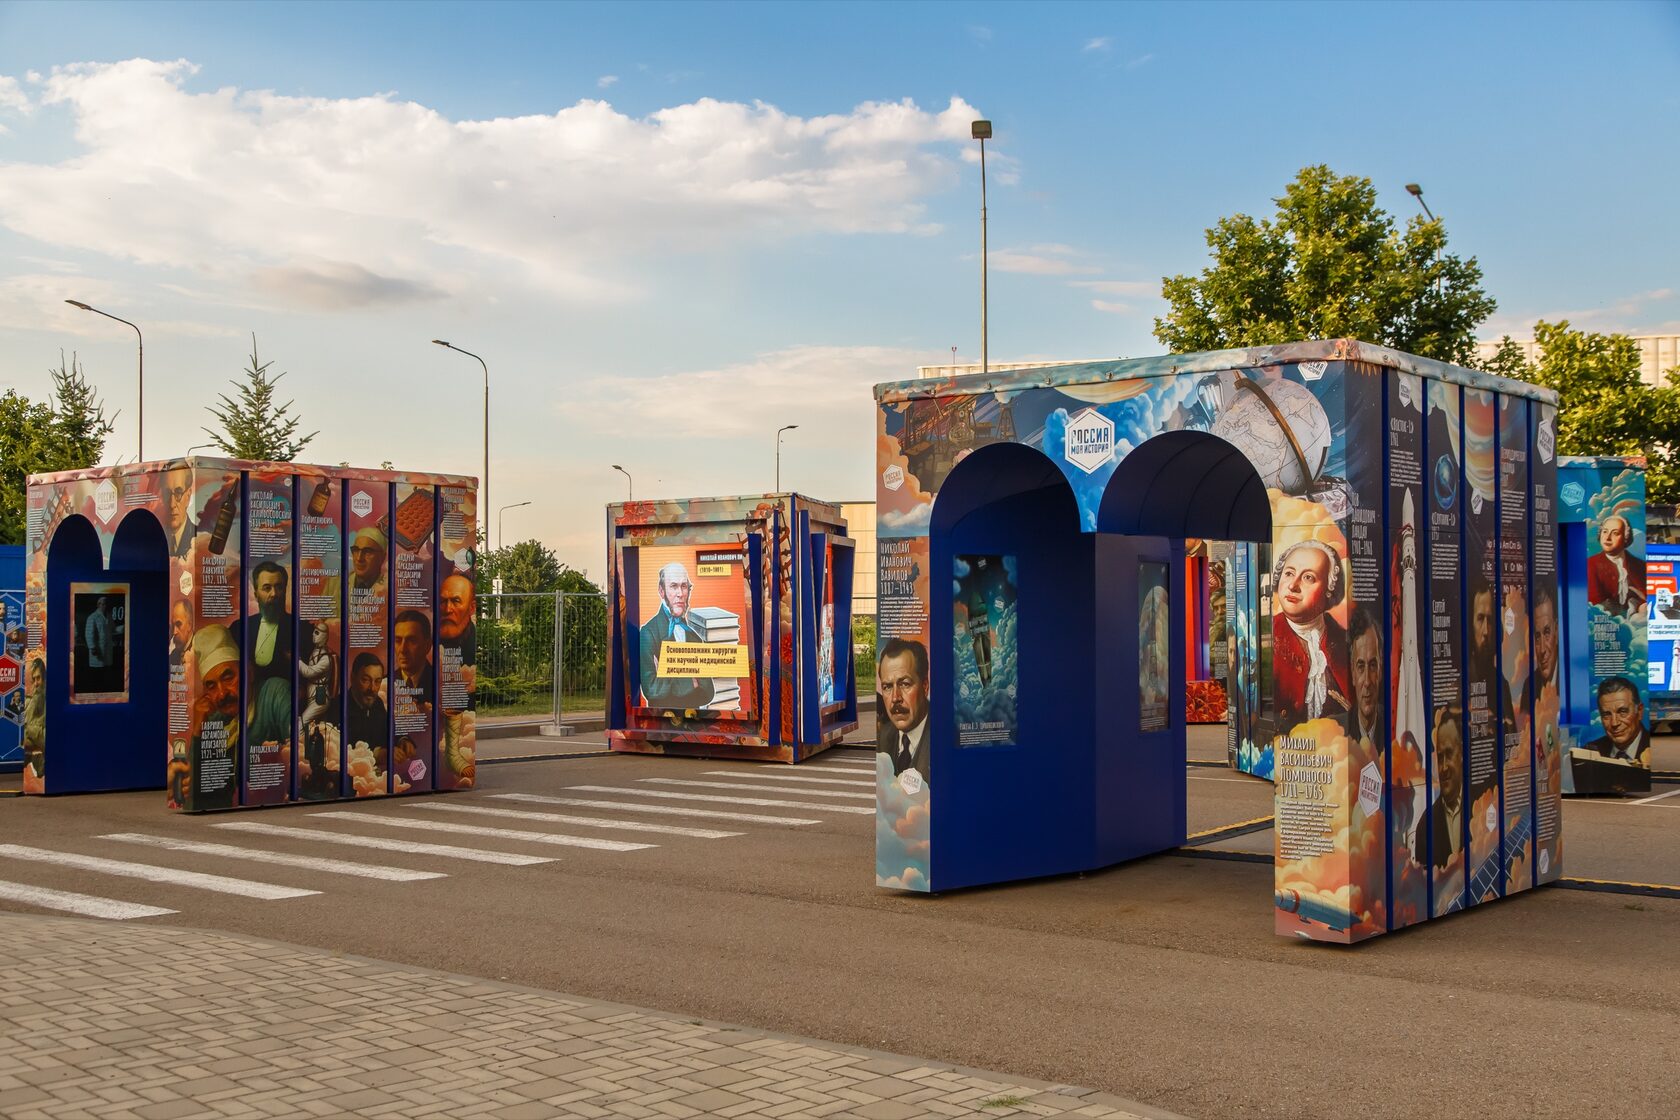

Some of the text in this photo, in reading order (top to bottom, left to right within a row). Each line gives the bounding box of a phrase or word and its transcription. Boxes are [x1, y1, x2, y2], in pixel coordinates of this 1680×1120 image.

[1072, 427, 1109, 444] РОССИЯ
[1071, 444, 1108, 455] МОЯ ИСТОРИЯ
[112, 606, 124, 620] 80
[666, 646, 711, 654] Основоположник
[677, 656, 698, 665] научной
[700, 657, 736, 665] медицинской
[1362, 775, 1379, 796] РОССИЯ
